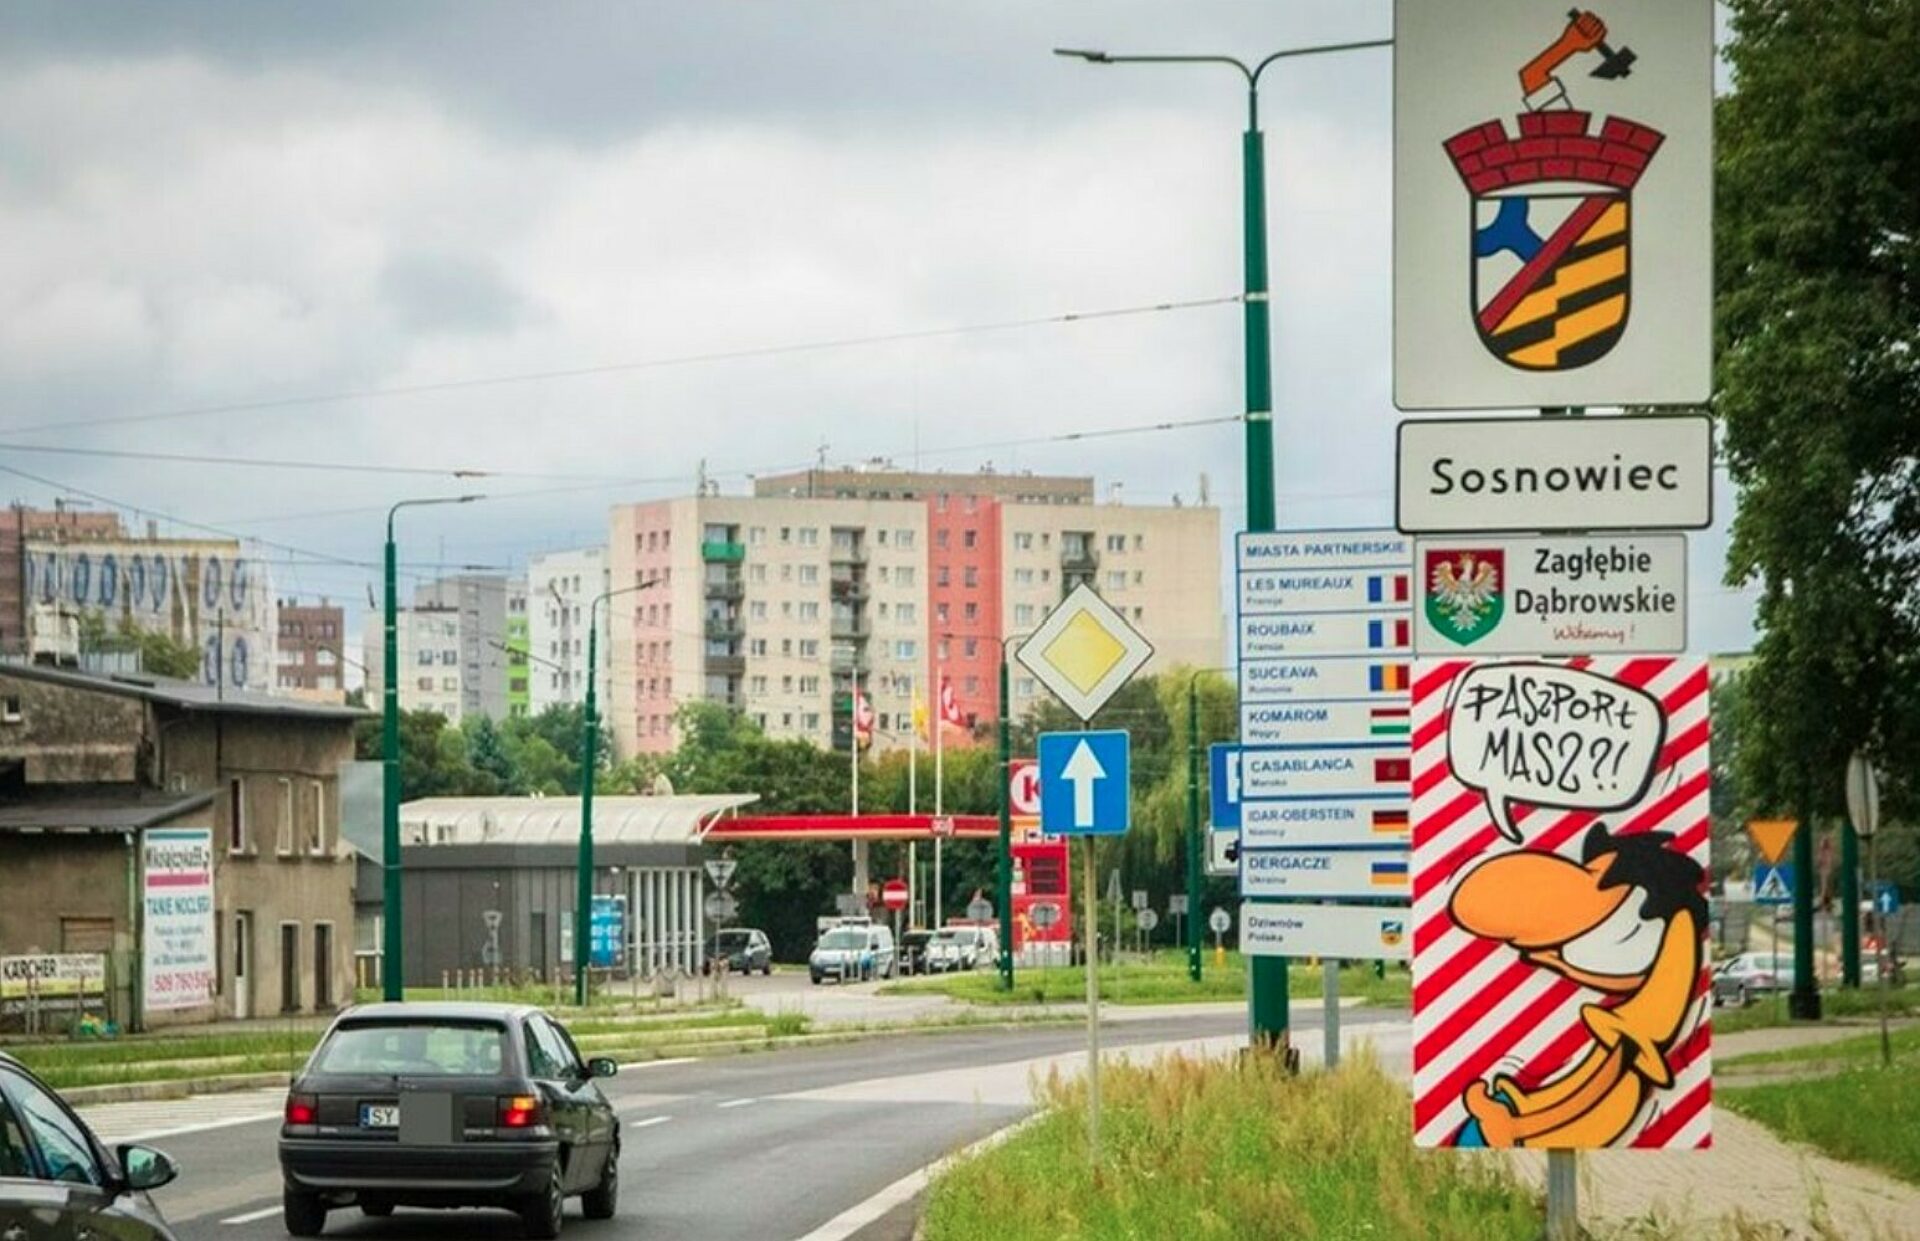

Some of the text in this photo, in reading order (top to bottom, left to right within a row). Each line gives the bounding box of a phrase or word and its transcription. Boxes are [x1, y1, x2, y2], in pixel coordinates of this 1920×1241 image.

[1430, 454, 1678, 494] Sosnowiec
[1246, 541, 1405, 557] MIASTA PARTNERSKIE
[1535, 545, 1652, 580] Zagłębie
[1247, 576, 1353, 591] LES MUREAUX
[1515, 585, 1676, 621] Dąbrowskie
[1248, 623, 1314, 636] ROUBAIX
[1249, 666, 1318, 679] SUCEAVA
[1250, 708, 1328, 723] KOMAROM
[1251, 758, 1354, 773] CASABLANCA
[1249, 808, 1355, 822] IDAR-OBERSTEIN
[1250, 856, 1331, 870] DERGACZE
[1250, 916, 1303, 929] Dziwnów
[373, 1109, 393, 1124] SY
